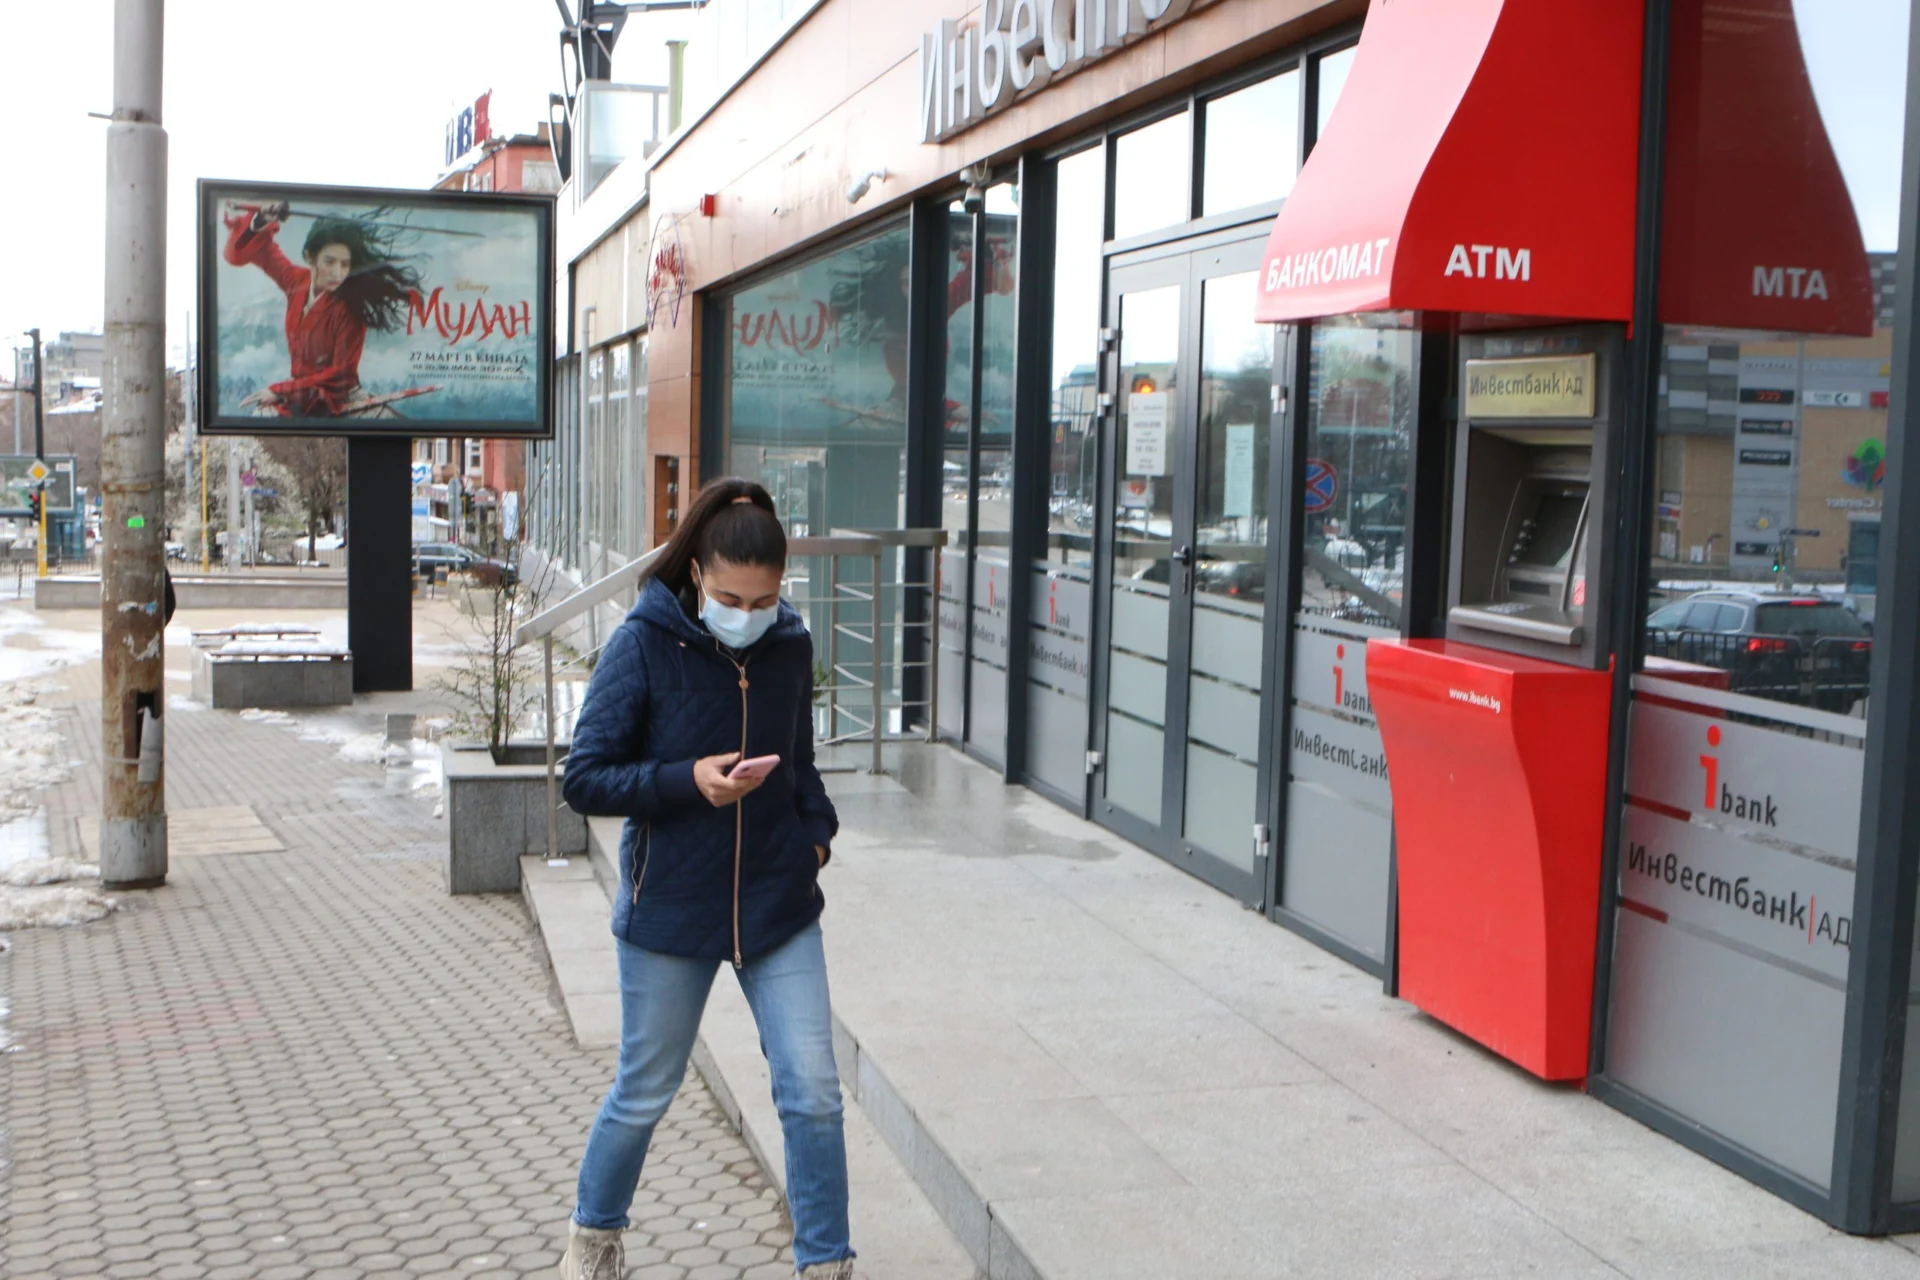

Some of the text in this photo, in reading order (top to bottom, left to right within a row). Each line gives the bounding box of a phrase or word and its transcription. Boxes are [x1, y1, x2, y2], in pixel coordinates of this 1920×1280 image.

[917, 0, 1190, 144] Инвест
[1265, 238, 1390, 292] БАНКОМАТ
[1444, 244, 1531, 281] ATM
[409, 352, 529, 365] 27 МАРТ В КИНАТА
[1565, 375, 1583, 396] АД
[1449, 688, 1501, 714] www.ibank.bg
[1816, 911, 1850, 950] АД
